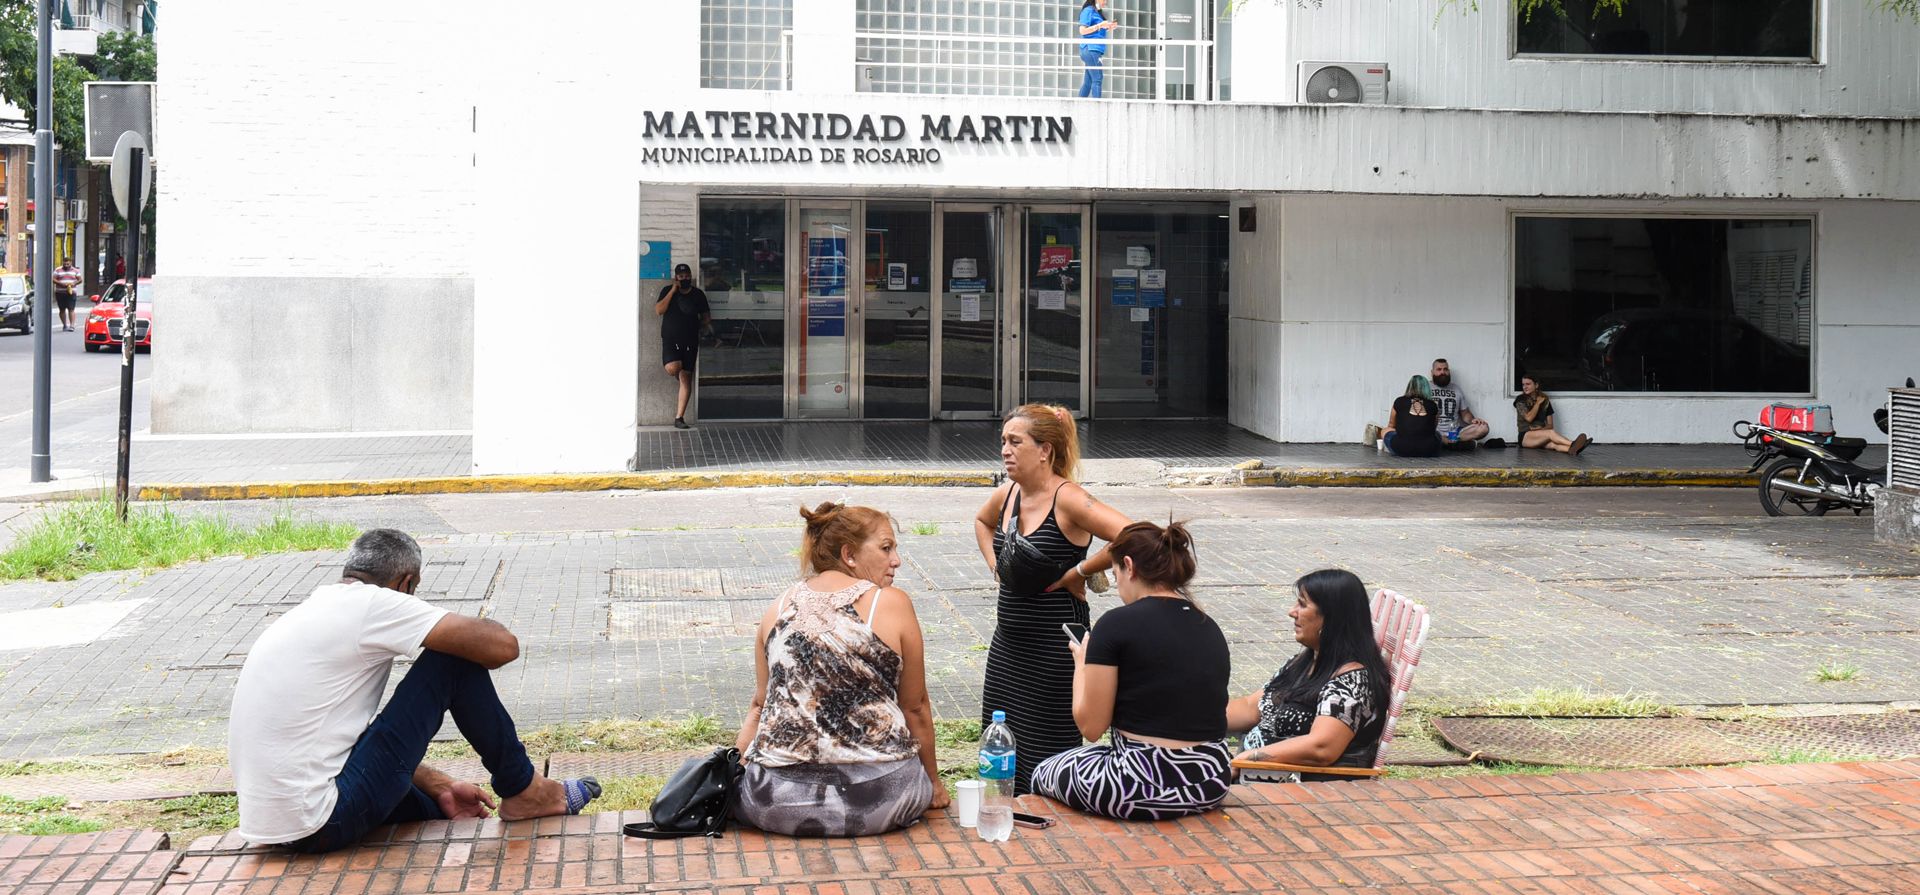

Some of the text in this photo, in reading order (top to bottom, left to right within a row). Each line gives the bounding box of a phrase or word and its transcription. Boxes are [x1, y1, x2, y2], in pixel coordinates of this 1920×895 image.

[642, 111, 1072, 143] MATERNIDAD MARTIN
[641, 147, 941, 163] MUNICIPALIDAD DE ROSARIO
